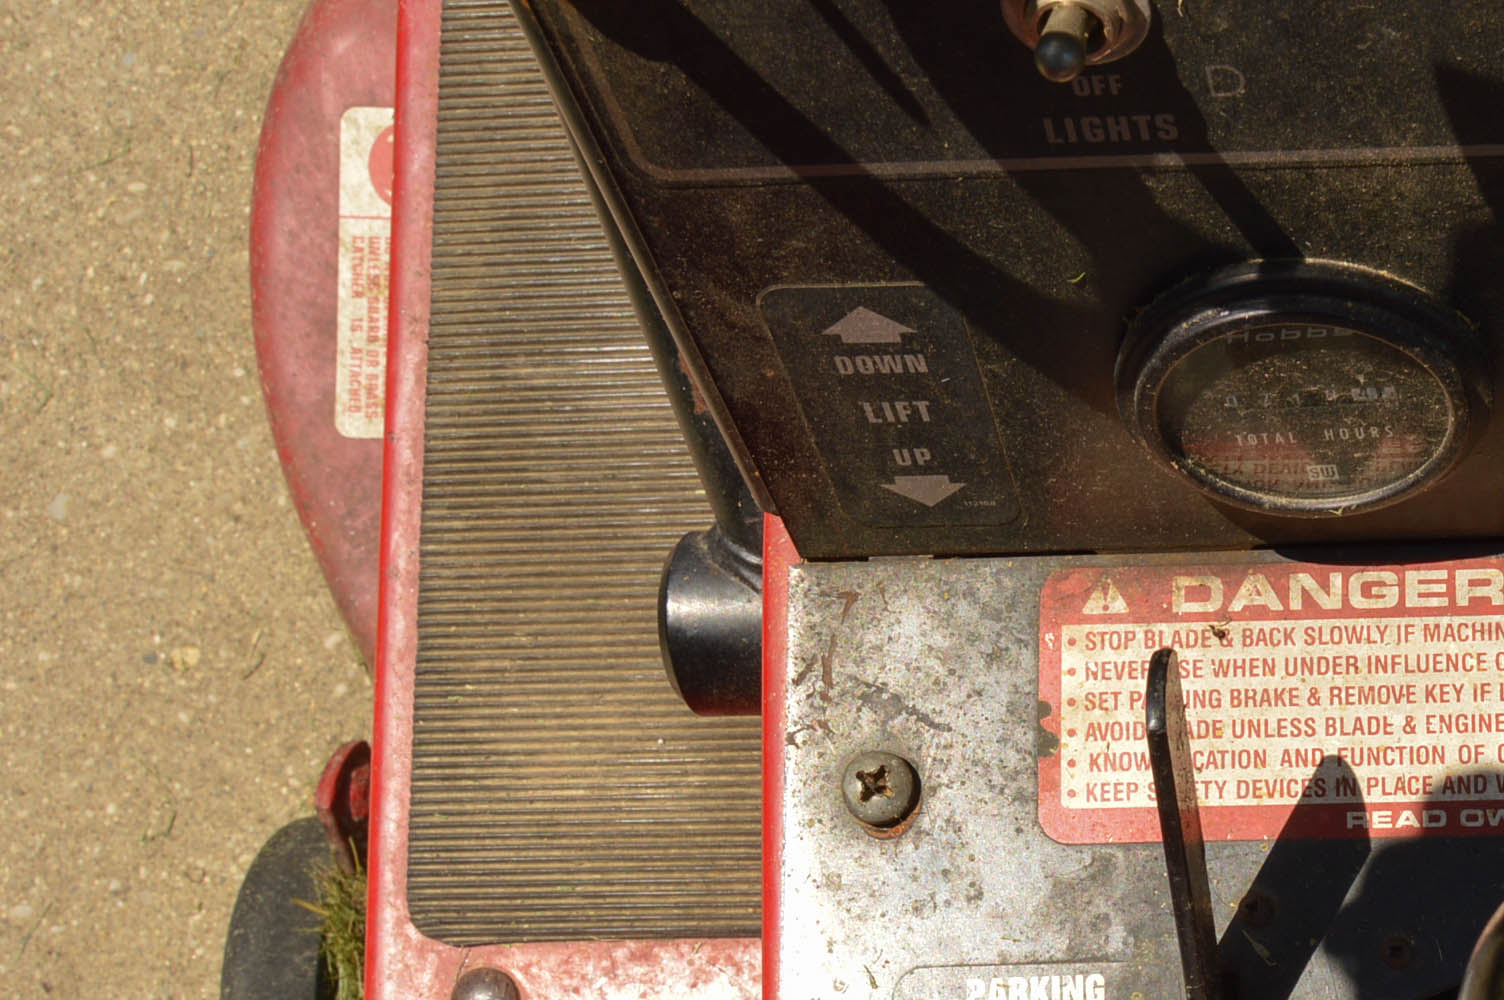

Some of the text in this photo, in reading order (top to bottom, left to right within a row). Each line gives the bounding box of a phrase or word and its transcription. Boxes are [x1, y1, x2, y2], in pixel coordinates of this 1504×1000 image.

[1072, 74, 1122, 97] OFF
[1042, 114, 1179, 144] LIGHTS
[833, 354, 928, 375] DOWN
[860, 400, 931, 424] LIFT
[1235, 425, 1394, 447] TOTAL HOURS
[892, 448, 931, 466] UP
[1171, 568, 1504, 614] DANGER
[1085, 630, 1136, 650] STOP
[1144, 628, 1212, 651] BLADE
[1219, 627, 1234, 648] &
[1242, 626, 1296, 648] BACK
[1303, 624, 1389, 646] SLOWLY
[1396, 623, 1415, 645] IF
[1211, 657, 1275, 679] WHEN
[1284, 655, 1360, 677] UNDER
[1367, 652, 1488, 675] INFLUENCE
[1084, 691, 1121, 711] SET
[1129, 689, 1222, 711] PING
[1230, 686, 1301, 708] BRAKE
[1307, 687, 1321, 707] &
[1329, 684, 1417, 706] REMOVE
[1425, 682, 1465, 704] KEY
[1473, 682, 1491, 703] IF
[1085, 720, 1147, 742] AVOID
[1232, 717, 1316, 739] UNLESS
[1325, 715, 1394, 737] BLADE
[1402, 714, 1417, 735] &
[1089, 751, 1151, 772] KNOW
[1193, 749, 1267, 770] CATION
[1280, 747, 1324, 769] AND
[1337, 744, 1445, 767] FUNCTION
[1458, 743, 1485, 765] OF
[1086, 782, 1139, 803] KEEP
[1237, 777, 1327, 800] DEVICES
[1336, 775, 1356, 797] IN
[1366, 774, 1433, 796] PLACE
[1441, 773, 1488, 795] AND
[1347, 809, 1447, 829] READ
